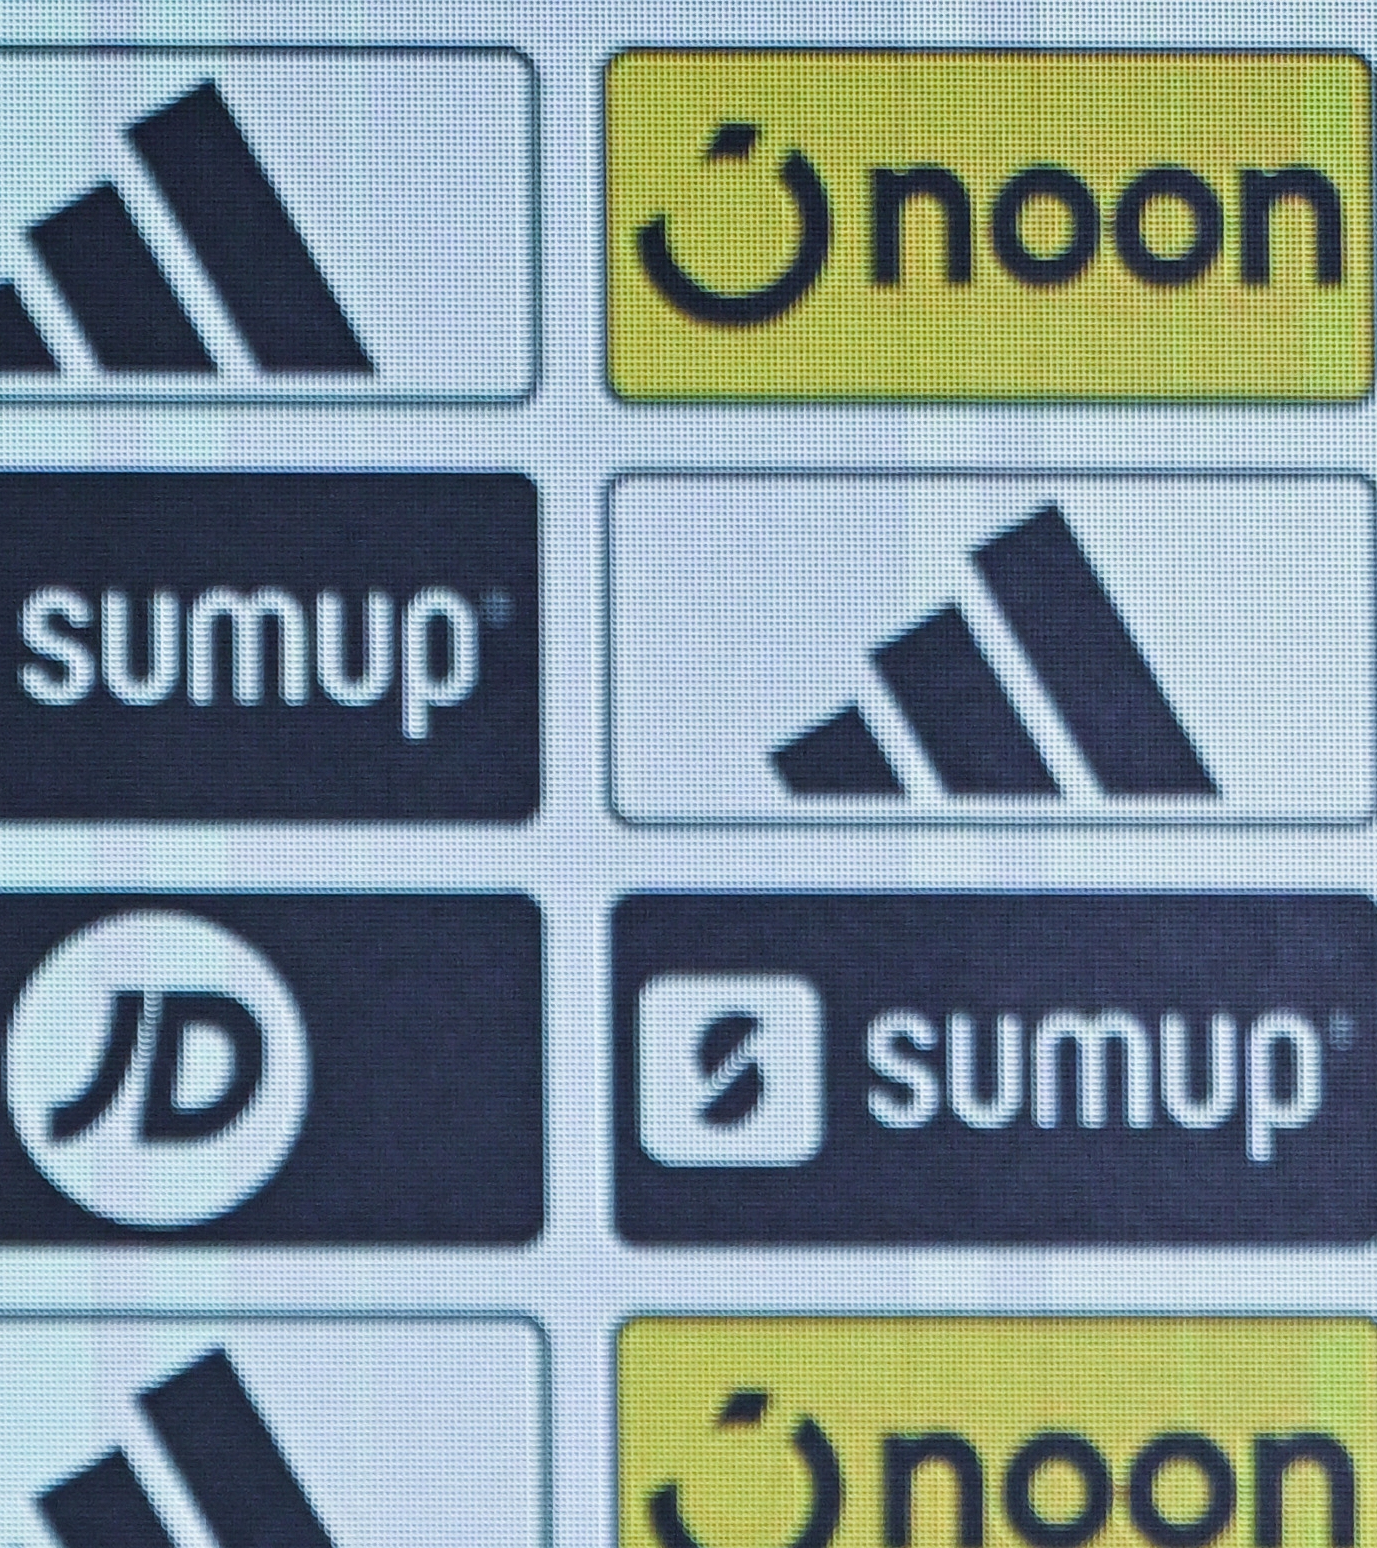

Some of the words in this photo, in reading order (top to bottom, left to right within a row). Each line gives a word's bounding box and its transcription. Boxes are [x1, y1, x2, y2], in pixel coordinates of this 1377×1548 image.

[869, 163, 1343, 286] noon
[18, 586, 480, 739] sumup
[47, 988, 264, 1146] JD
[866, 1009, 1323, 1161] sumup
